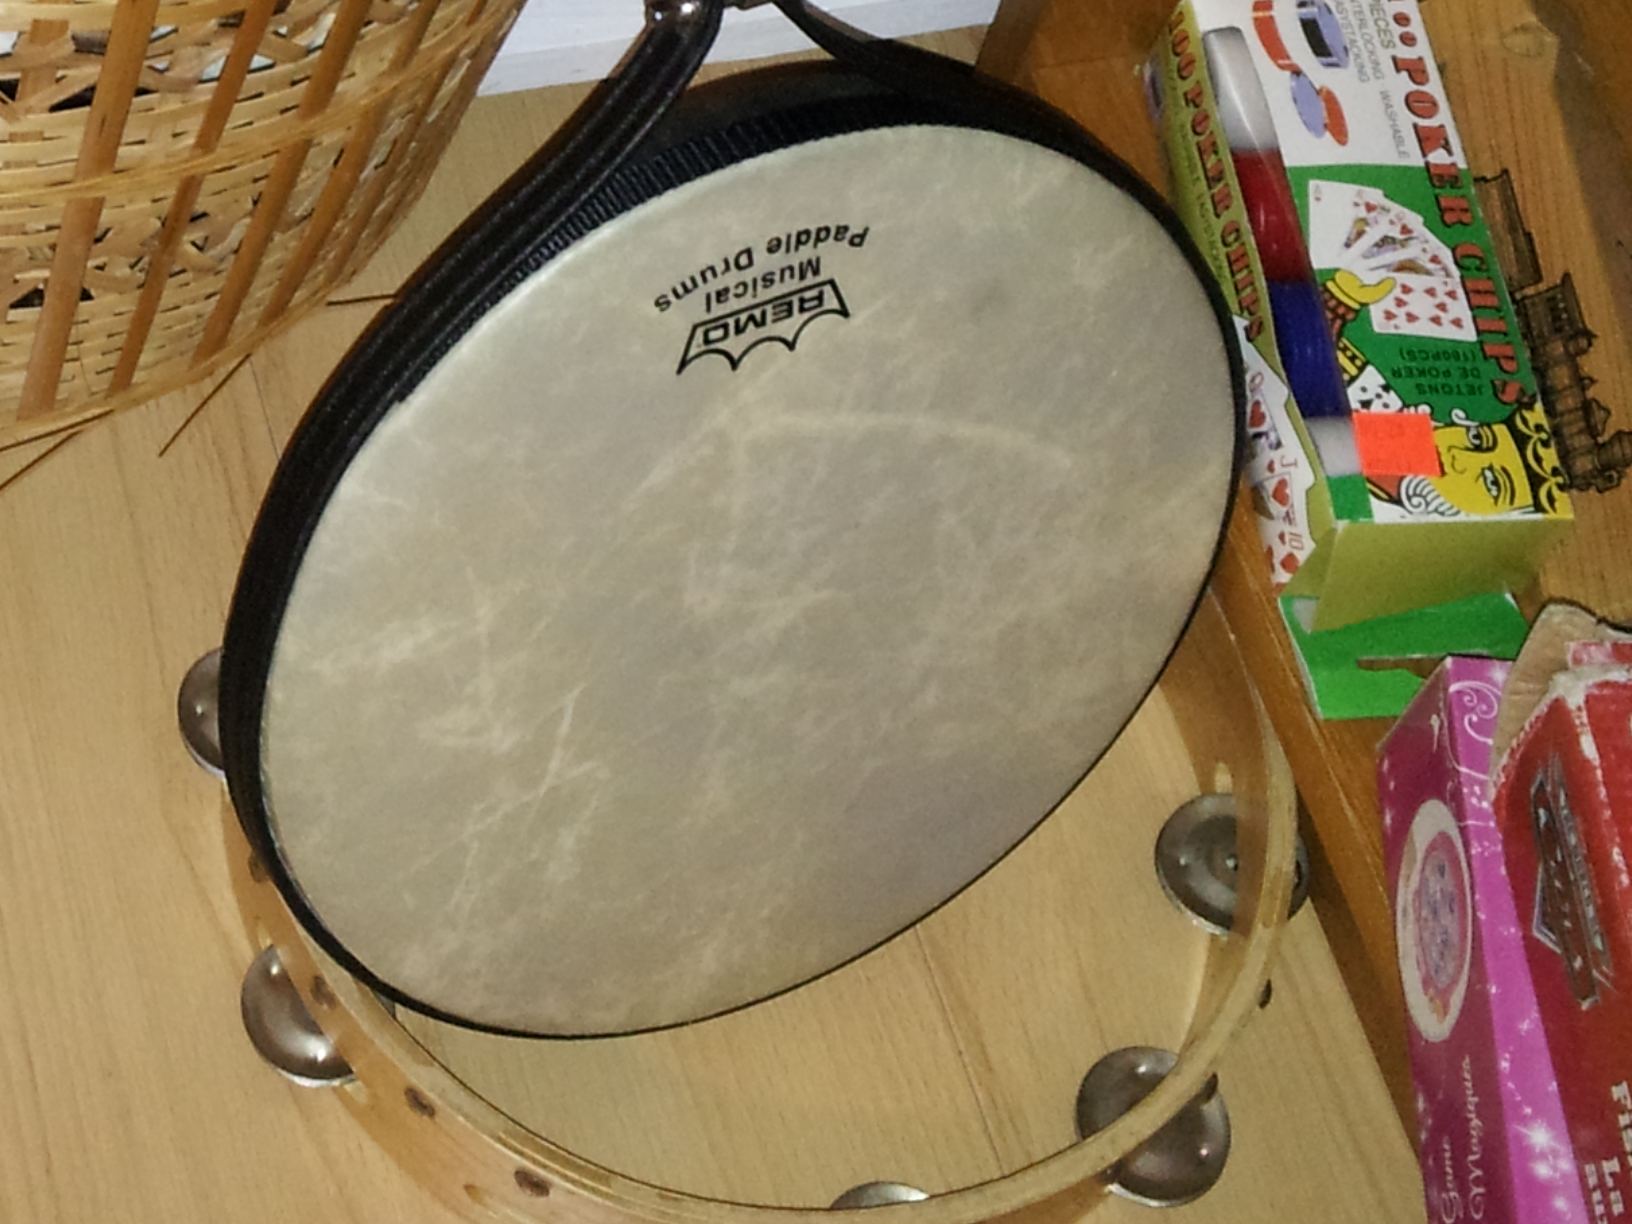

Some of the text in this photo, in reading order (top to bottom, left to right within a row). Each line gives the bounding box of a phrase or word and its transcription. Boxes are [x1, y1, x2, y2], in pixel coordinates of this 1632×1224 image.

[1379, 89, 1411, 161] WASHABLE
[1183, 80, 1234, 219] POKER
[1221, 220, 1264, 343] CHIPS
[1391, 54, 1475, 228] POKER
[1452, 242, 1536, 405] CHIPS
[653, 224, 870, 313] Paddle Drums
[704, 256, 822, 314] Musical
[701, 288, 826, 347] REMO
[1391, 366, 1481, 379] DE POKER
[1415, 383, 1486, 396] JETONS
